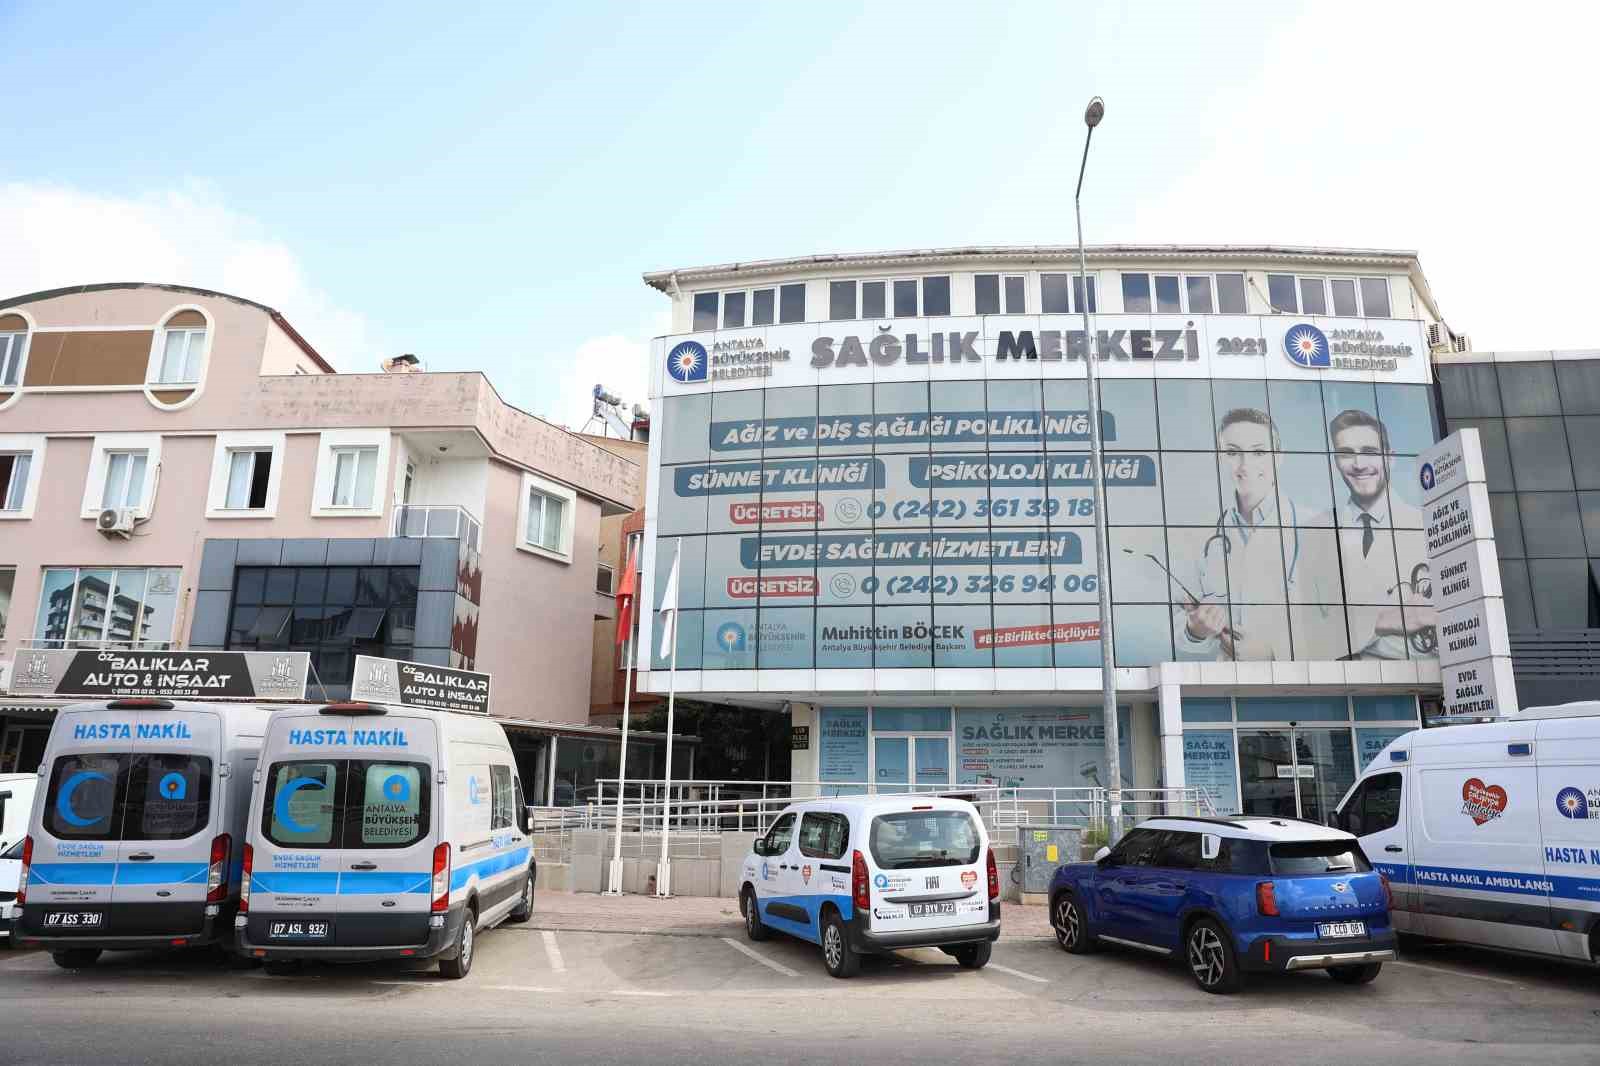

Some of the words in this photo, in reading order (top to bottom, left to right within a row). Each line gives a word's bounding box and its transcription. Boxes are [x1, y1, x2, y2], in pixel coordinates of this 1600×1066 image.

[713, 337, 764, 353] ANTALYA
[809, 323, 982, 369] SAĞLIK
[996, 320, 1199, 361] MERKEZİ
[1216, 338, 1268, 357] 2021
[722, 423, 778, 445] AĞIZ
[783, 426, 808, 440] ve
[811, 420, 851, 441] DİŞ
[856, 416, 952, 438] SAĞLIĞI
[687, 468, 778, 491] SÜNNET
[781, 462, 868, 486] KLİNİĞİ
[923, 460, 1050, 482] PSİKOLOJİ
[733, 503, 817, 521] ÜCRETSİZ
[866, 501, 887, 520] 0
[892, 499, 968, 521] (242)
[973, 498, 1022, 518] 361
[1025, 498, 1060, 518] 39
[1068, 498, 1094, 517] 18
[1432, 504, 1449, 521] AĞIZ
[1450, 499, 1460, 511] VE
[1427, 524, 1440, 537] DİŞ
[754, 542, 821, 562] EVDE
[824, 538, 914, 560] SAĞLIK
[914, 536, 1066, 559] HİZMETLERİ
[1440, 561, 1468, 580] SÜNNET
[731, 578, 815, 596] ÜCRETSİZ
[860, 576, 880, 594] 0
[886, 575, 959, 597] (242)
[964, 574, 1016, 593] 326
[1021, 574, 1057, 593] 94
[1063, 574, 1097, 593] 06
[1442, 577, 1471, 597] KLİNİĞİ
[821, 625, 898, 642] Muhittin
[902, 621, 964, 640] BÖCEK
[1442, 614, 1480, 637] PSİKOLOJİ
[1448, 634, 1478, 653] KLİNİĞİ
[98, 653, 114, 661] ÖZ
[111, 658, 209, 672] BALIKLAR
[402, 665, 417, 674] ÖZ
[1458, 669, 1477, 683] EVDE
[82, 673, 139, 687] AUTO
[143, 673, 153, 687] &
[413, 673, 487, 692] BALIKLAR
[403, 685, 437, 697] AUTO
[1456, 684, 1485, 699] SAĞLIK
[74, 724, 132, 740] HASTA
[136, 720, 192, 739] NAKİL
[289, 728, 347, 745] HASTA
[352, 727, 409, 746] NAKİL
[961, 722, 1034, 740] SAĞLIK
[1186, 739, 1226, 750] SAĞLIK
[1184, 750, 1231, 760] MERKEZİ
[366, 804, 406, 814] ANTALYA
[1544, 846, 1588, 865] HASTA
[925, 875, 940, 890] FIAT
[1416, 870, 1450, 883] HASTA
[1450, 873, 1484, 886] NAKİL
[1485, 876, 1555, 891] AMBULANSI
[49, 914, 60, 924] 07
[62, 914, 79, 924] ASS
[82, 914, 99, 925] 330
[274, 923, 285, 934] 07
[288, 923, 303, 934] ASL
[309, 923, 325, 934] 932
[1322, 924, 1332, 936] 07
